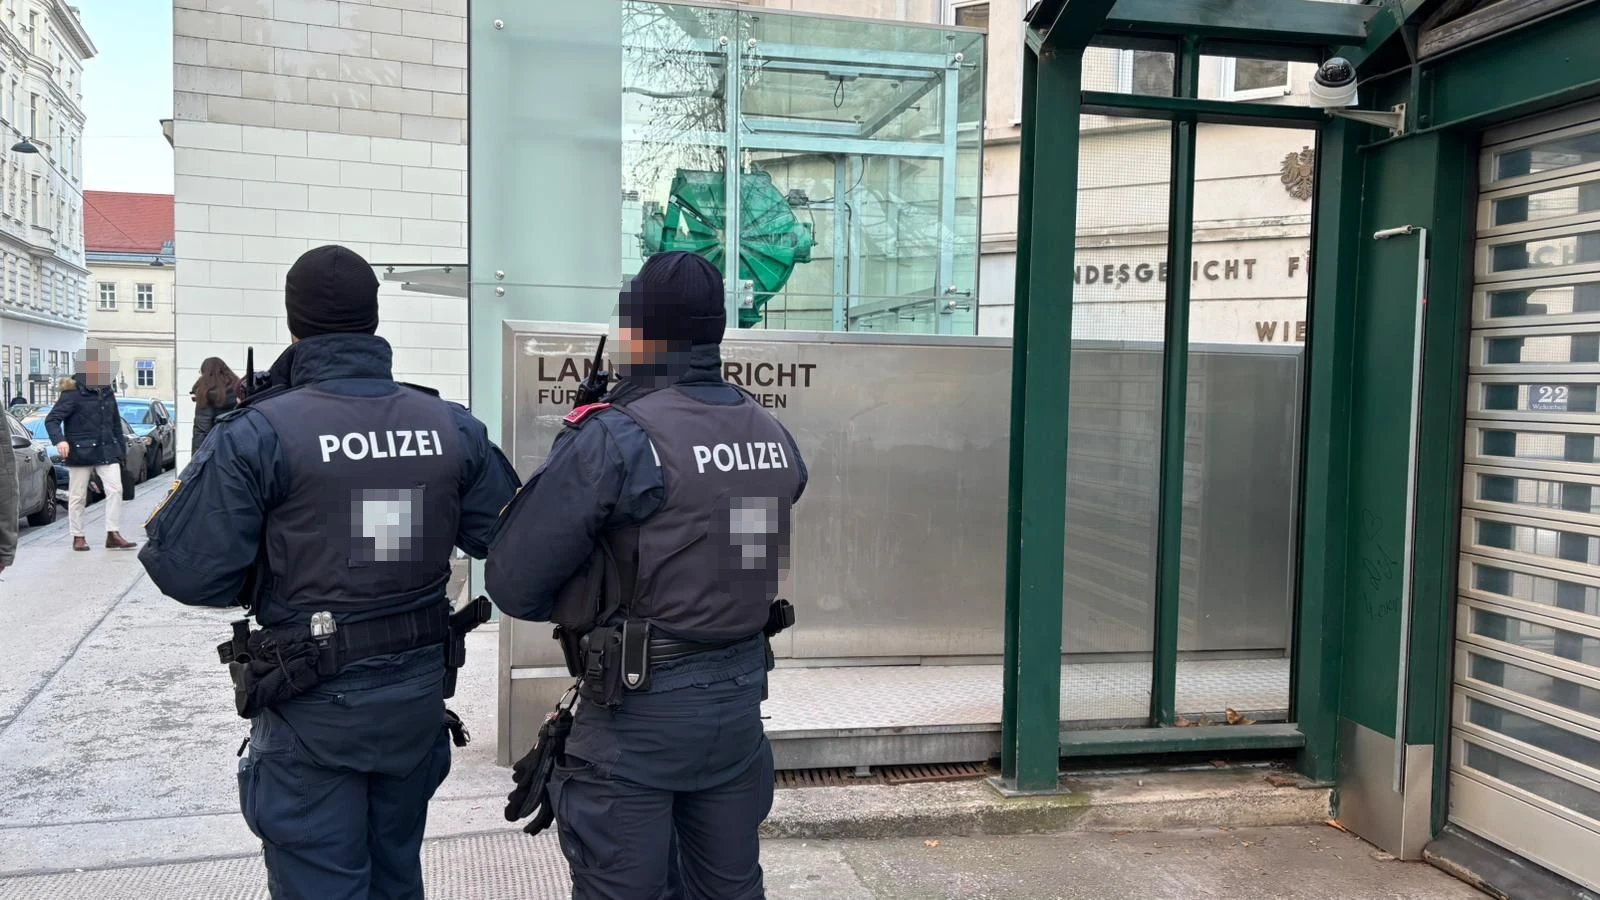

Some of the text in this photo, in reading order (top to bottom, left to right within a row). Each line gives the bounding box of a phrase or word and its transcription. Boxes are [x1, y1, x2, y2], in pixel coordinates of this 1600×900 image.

[1255, 321, 1306, 342] WIE
[1538, 386, 1568, 403] 22
[319, 430, 443, 463] POLIZEI
[692, 441, 789, 474] POLIZEI
